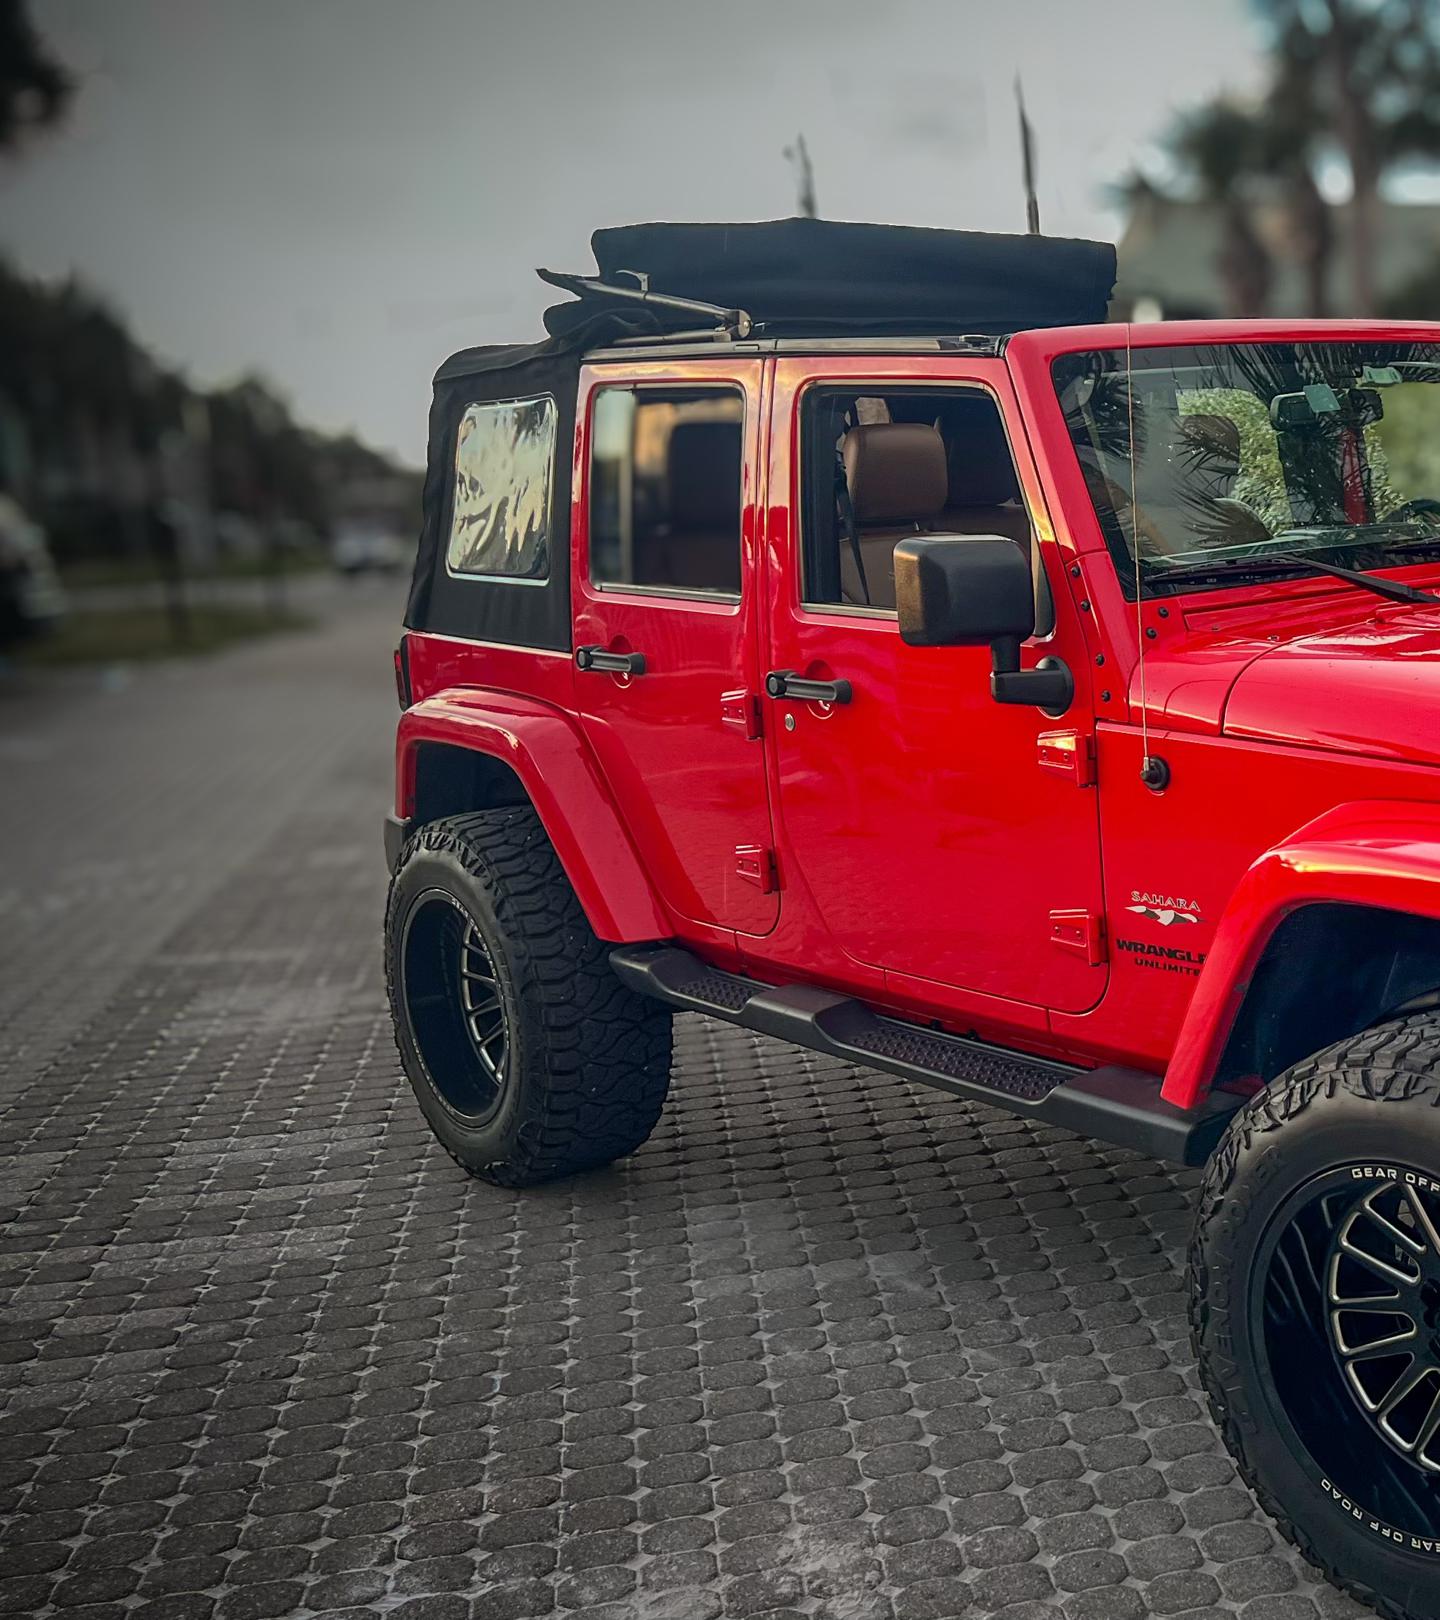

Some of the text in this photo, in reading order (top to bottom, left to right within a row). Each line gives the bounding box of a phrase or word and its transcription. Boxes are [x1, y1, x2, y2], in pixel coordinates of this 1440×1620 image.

[1131, 890, 1201, 912] SAHARA
[1351, 1167, 1397, 1180] GEAR
[1405, 1172, 1440, 1192] OFF
[1321, 1478, 1363, 1521] ROAD
[1369, 1521, 1404, 1543] OFF
